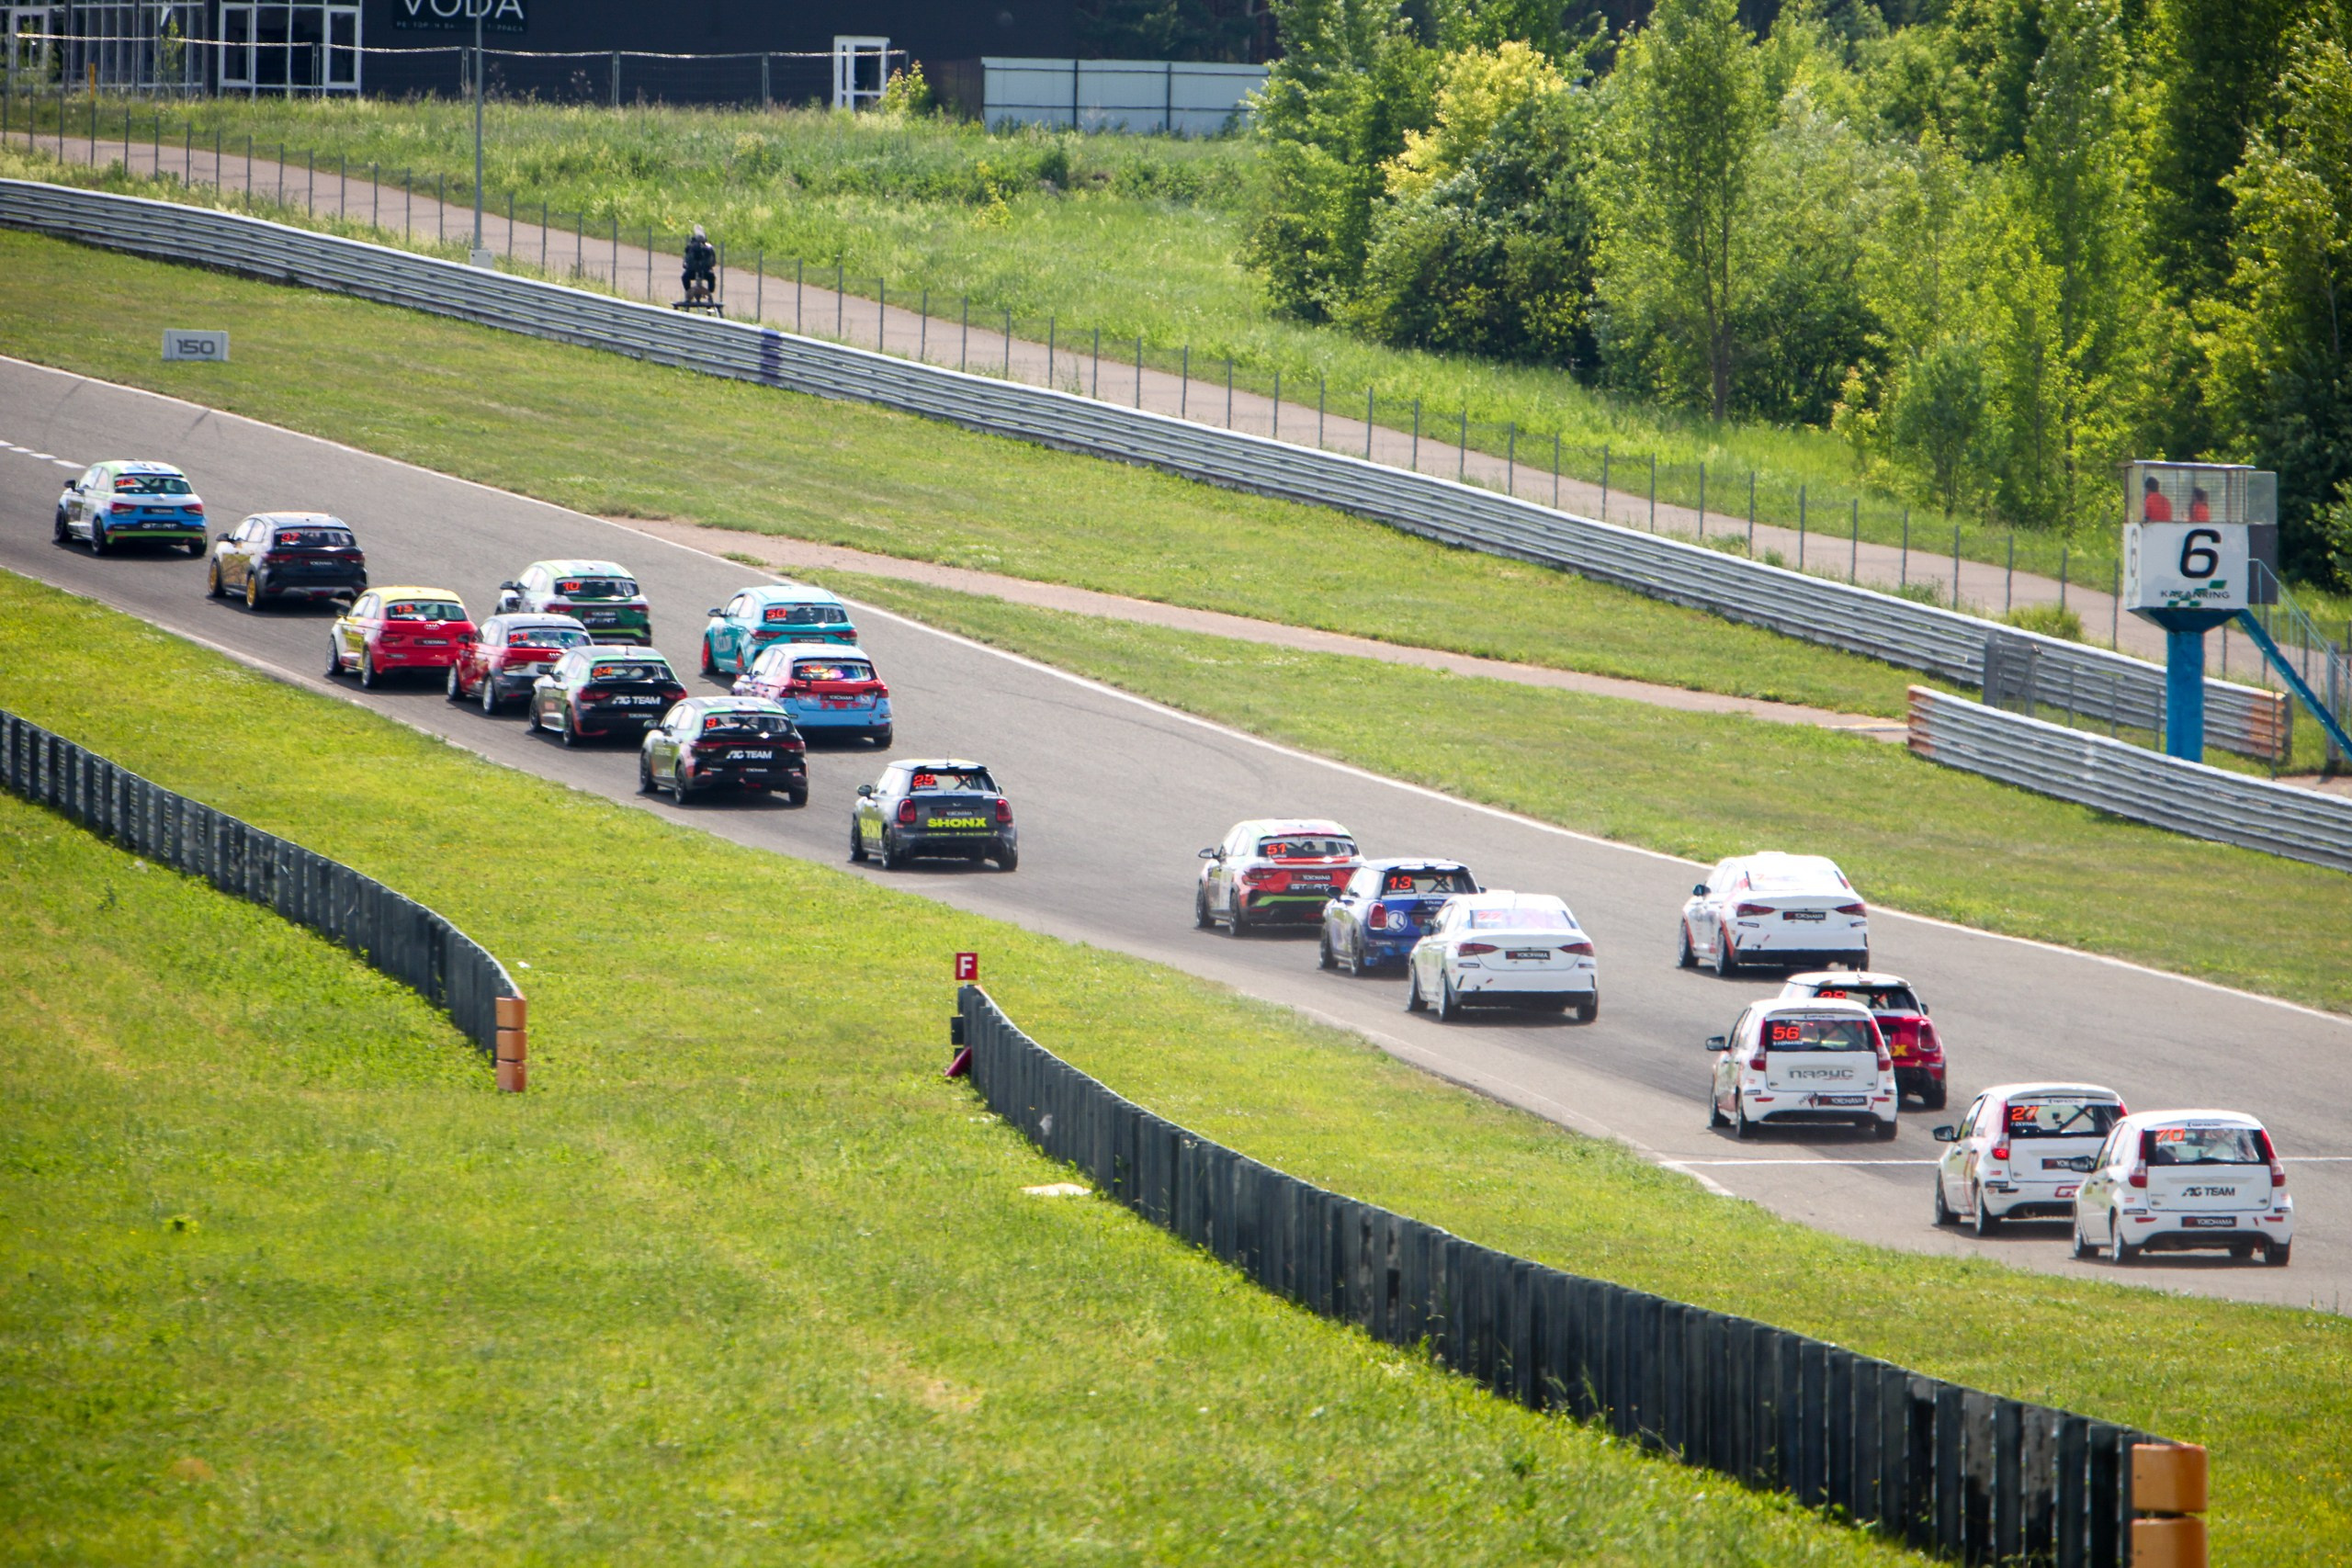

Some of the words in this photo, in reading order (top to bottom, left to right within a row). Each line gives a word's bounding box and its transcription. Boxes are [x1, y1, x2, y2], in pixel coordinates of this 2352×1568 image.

[176, 339, 215, 355] 150
[2179, 528, 2222, 579] 6
[562, 581, 581, 591] 10
[766, 607, 787, 619] 50
[509, 632, 528, 643] 21
[632, 695, 662, 705] TEAM
[745, 750, 773, 760] TEAM
[913, 773, 935, 787] 29
[927, 817, 987, 829] SHONX
[1266, 842, 1286, 855] 51
[1388, 875, 1412, 890] 13
[960, 956, 973, 977] F
[1772, 1026, 1801, 1040] 56
[2011, 1106, 2039, 1121] 27
[2156, 1129, 2186, 1142] 70
[2204, 1187, 2235, 1197] TEAM
